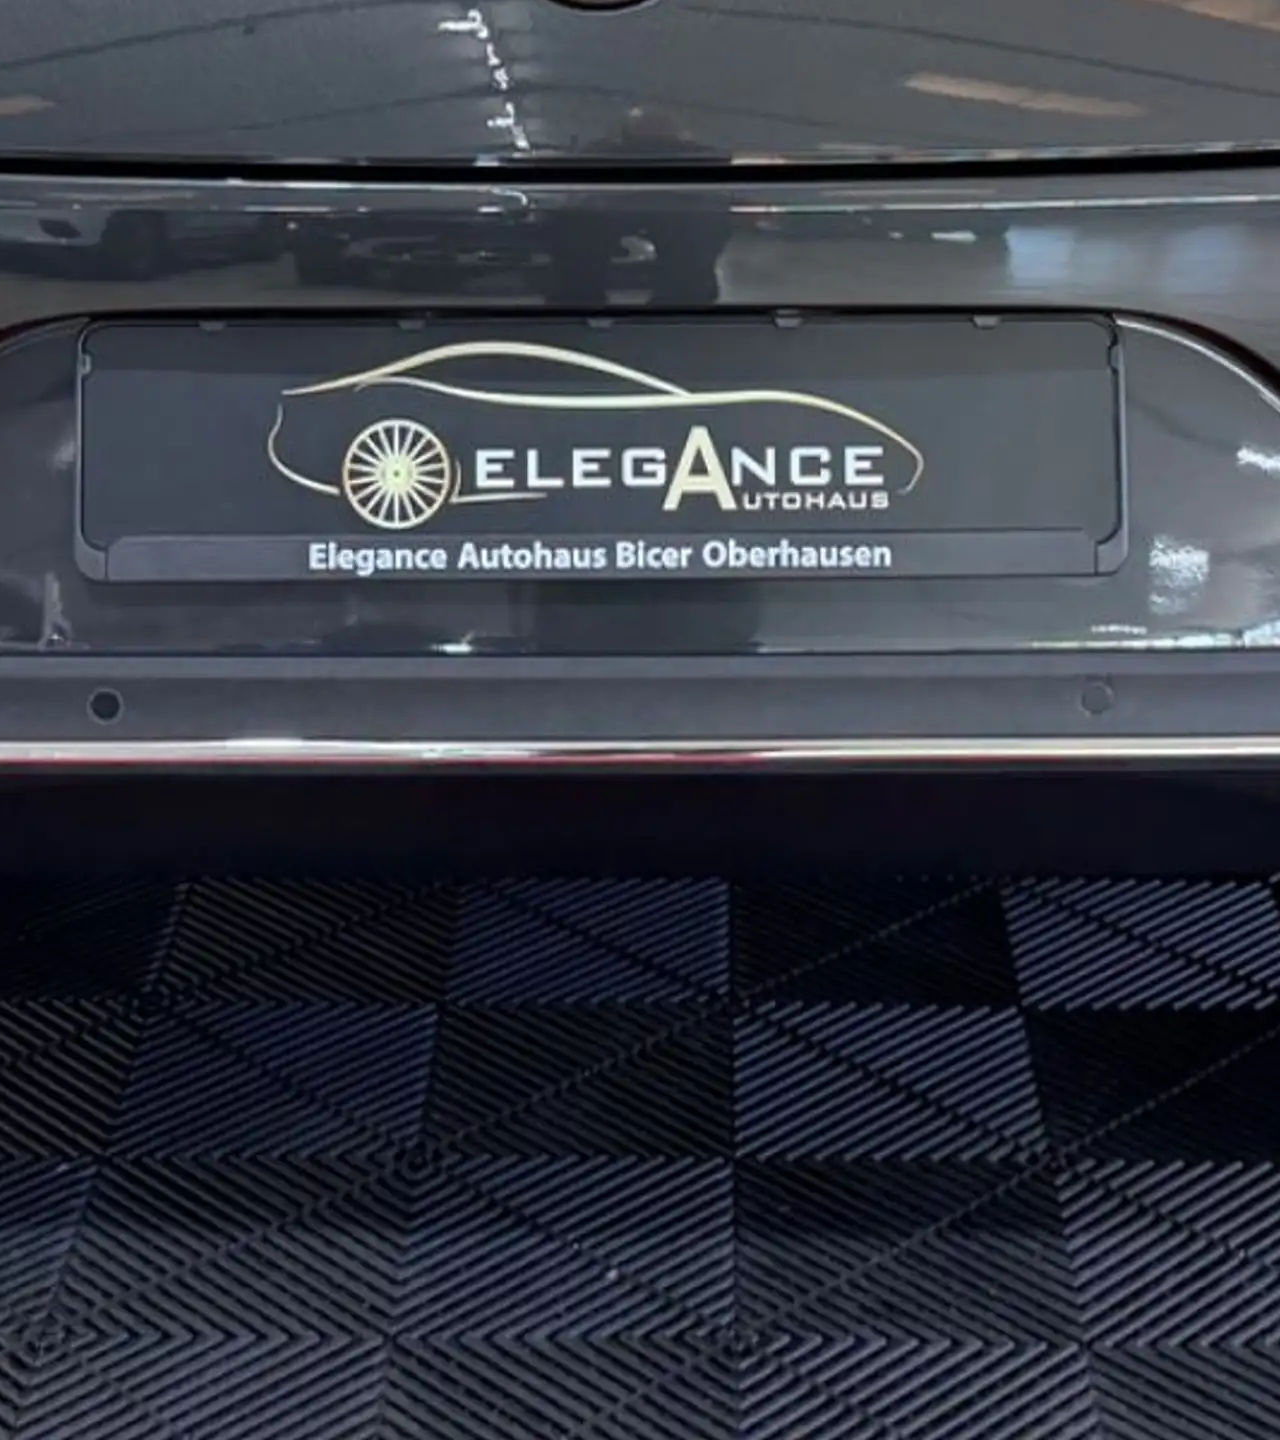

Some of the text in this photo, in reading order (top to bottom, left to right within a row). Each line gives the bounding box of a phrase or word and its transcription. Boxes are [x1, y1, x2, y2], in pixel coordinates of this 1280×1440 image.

[474, 424, 886, 512] ELEGANCE
[307, 539, 893, 577] Elegance Autohaus Bicer Oberhausen
